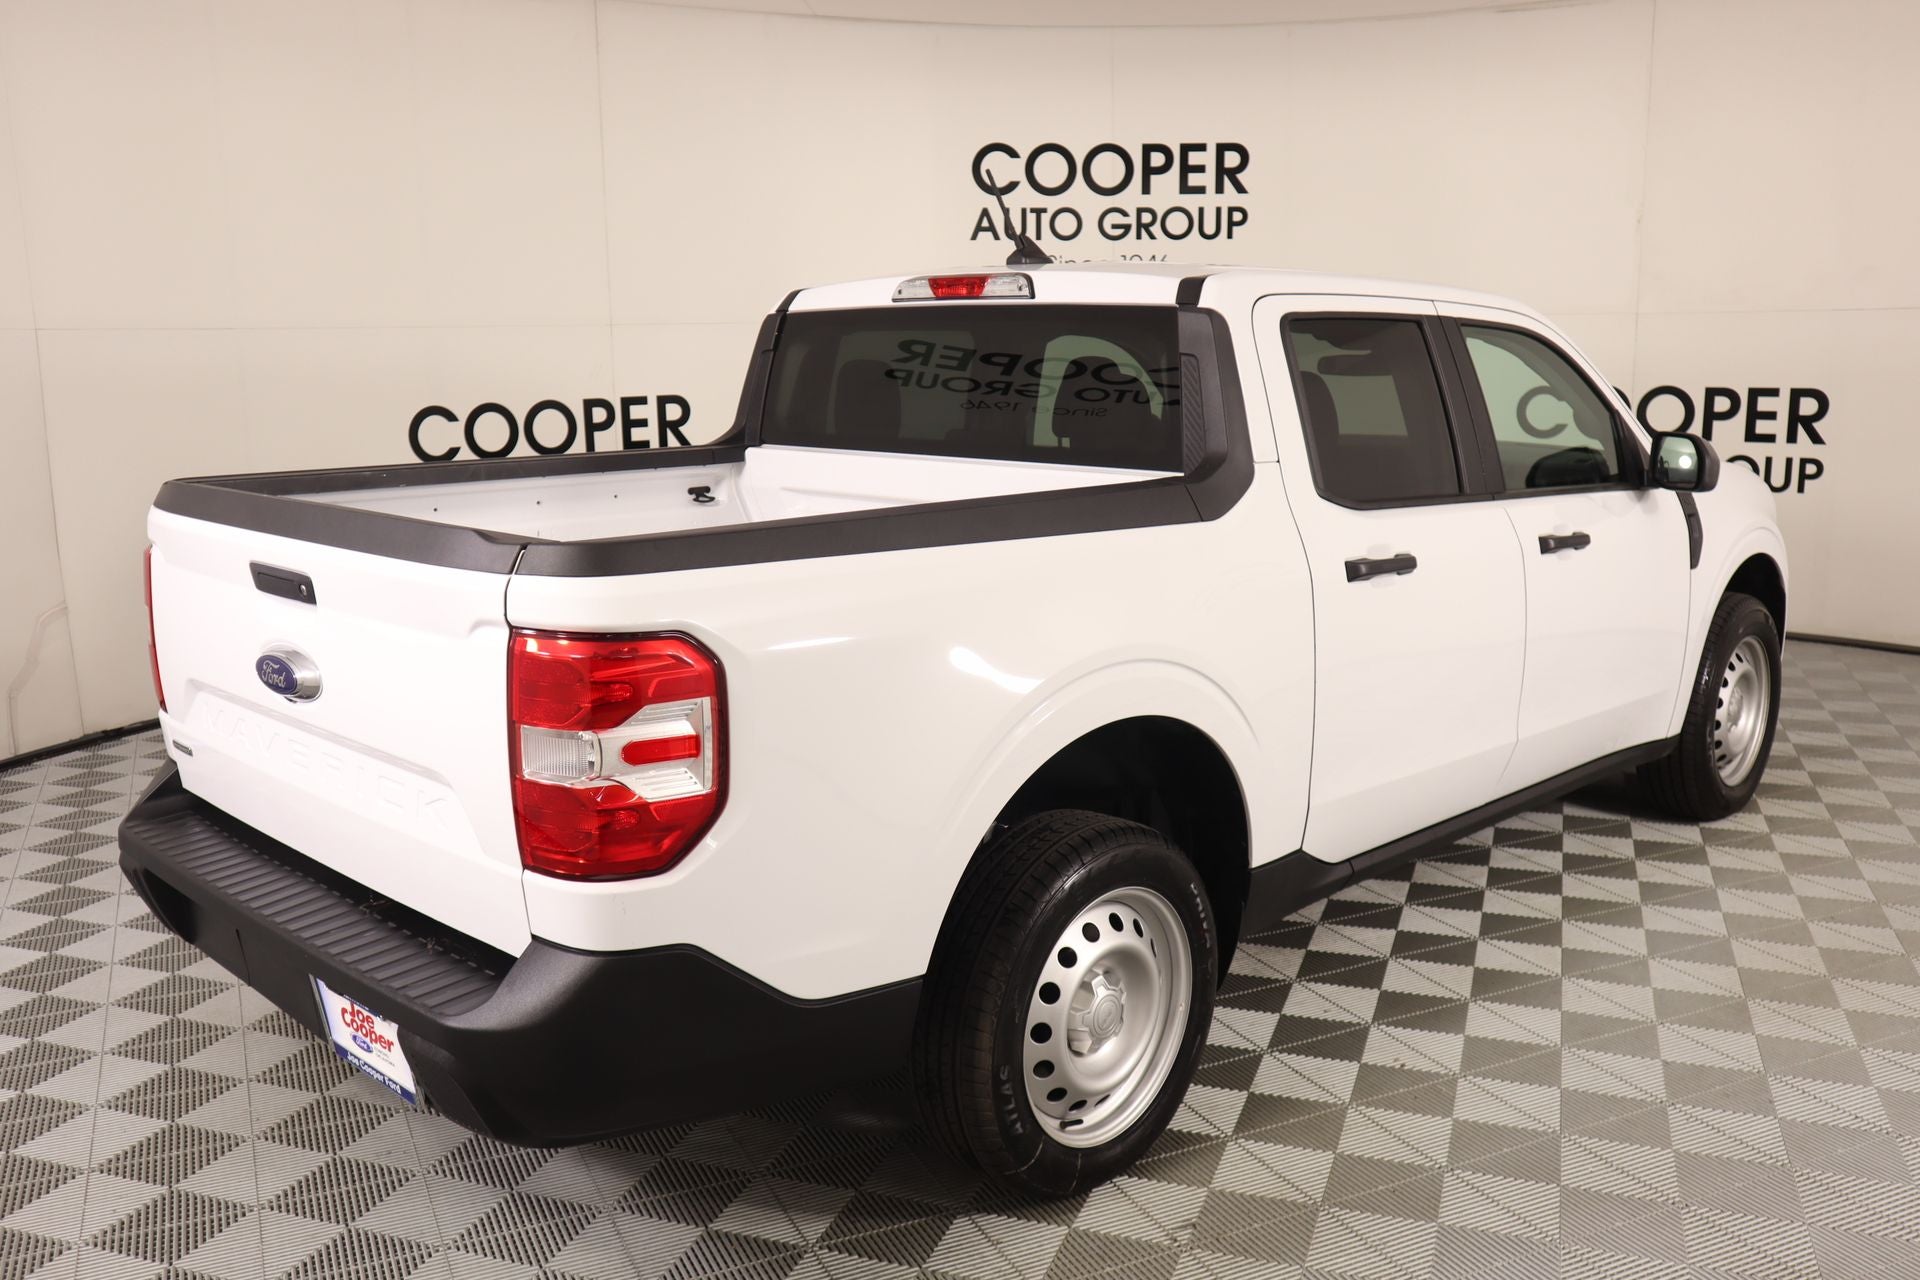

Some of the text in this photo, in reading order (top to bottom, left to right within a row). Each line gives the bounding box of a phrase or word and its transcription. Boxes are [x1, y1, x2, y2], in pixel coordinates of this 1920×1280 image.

[972, 142, 1250, 196] COOPER
[970, 206, 1249, 241] AUTO GROUP
[408, 395, 692, 463] COOPER
[262, 660, 286, 688] Ford
[341, 1006, 394, 1052] Cooper
[349, 1000, 375, 1029] Joe
